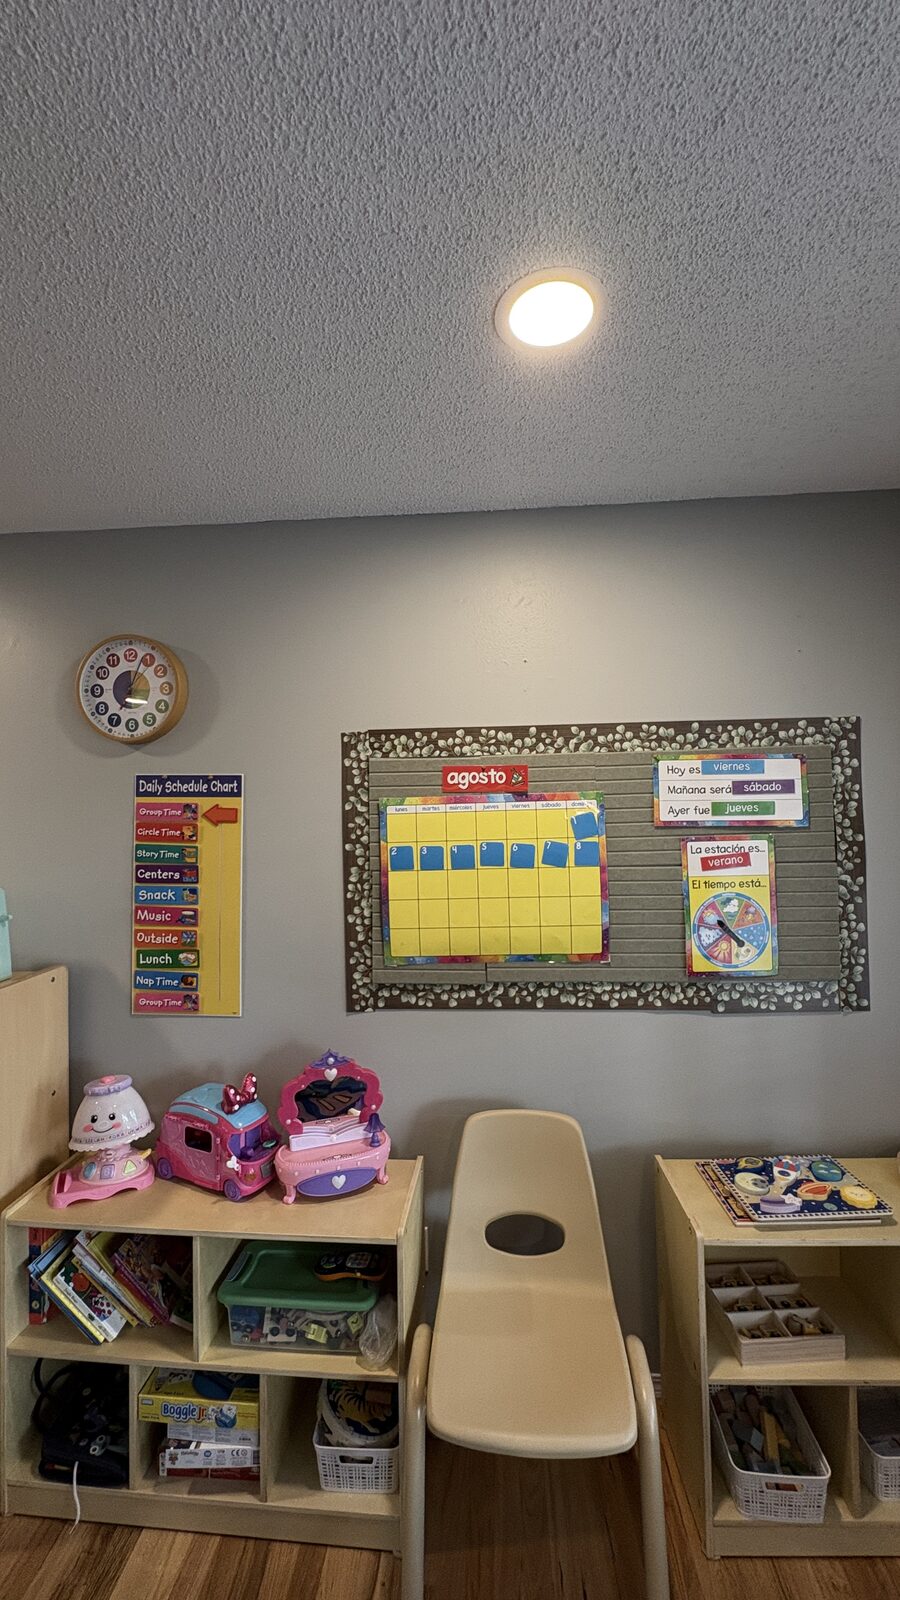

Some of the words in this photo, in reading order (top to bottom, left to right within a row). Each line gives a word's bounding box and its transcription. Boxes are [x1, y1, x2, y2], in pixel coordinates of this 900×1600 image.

[108, 656, 118, 666] 11
[126, 651, 136, 660] 12
[98, 668, 108, 678] 10
[666, 765, 686, 777] Hoy
[688, 767, 701, 775] es
[713, 762, 751, 771] viernes
[446, 768, 507, 790] agosto
[139, 779, 163, 795] Daily
[165, 779, 208, 793] Schedule
[210, 780, 238, 793] Chart
[667, 784, 706, 795] Mañana
[709, 784, 732, 795] será
[743, 781, 782, 792] sábado
[139, 807, 163, 817] Group
[163, 808, 182, 816] Time
[667, 805, 691, 817] Ayer
[693, 805, 710, 815] fue
[724, 803, 759, 815] jueves
[137, 827, 160, 836] Circle
[161, 828, 181, 837] Time
[136, 850, 159, 860] Story
[159, 850, 180, 859] Time
[391, 847, 398, 856] 2
[421, 847, 428, 855] 3
[451, 846, 458, 854] 4
[690, 845, 702, 855] La
[704, 844, 746, 855] estación
[707, 856, 744, 867] verano
[137, 868, 180, 880] Centers
[691, 879, 701, 889] El
[703, 879, 736, 891] tiempo
[138, 889, 176, 901] Snack
[136, 910, 172, 922] Music
[136, 932, 179, 944] Outside
[139, 953, 173, 964] Lunch
[136, 976, 154, 987] Nap
[155, 977, 179, 987] Time
[138, 998, 163, 1007] Group
[164, 998, 183, 1007] Time
[163, 1403, 197, 1419] Boggle
